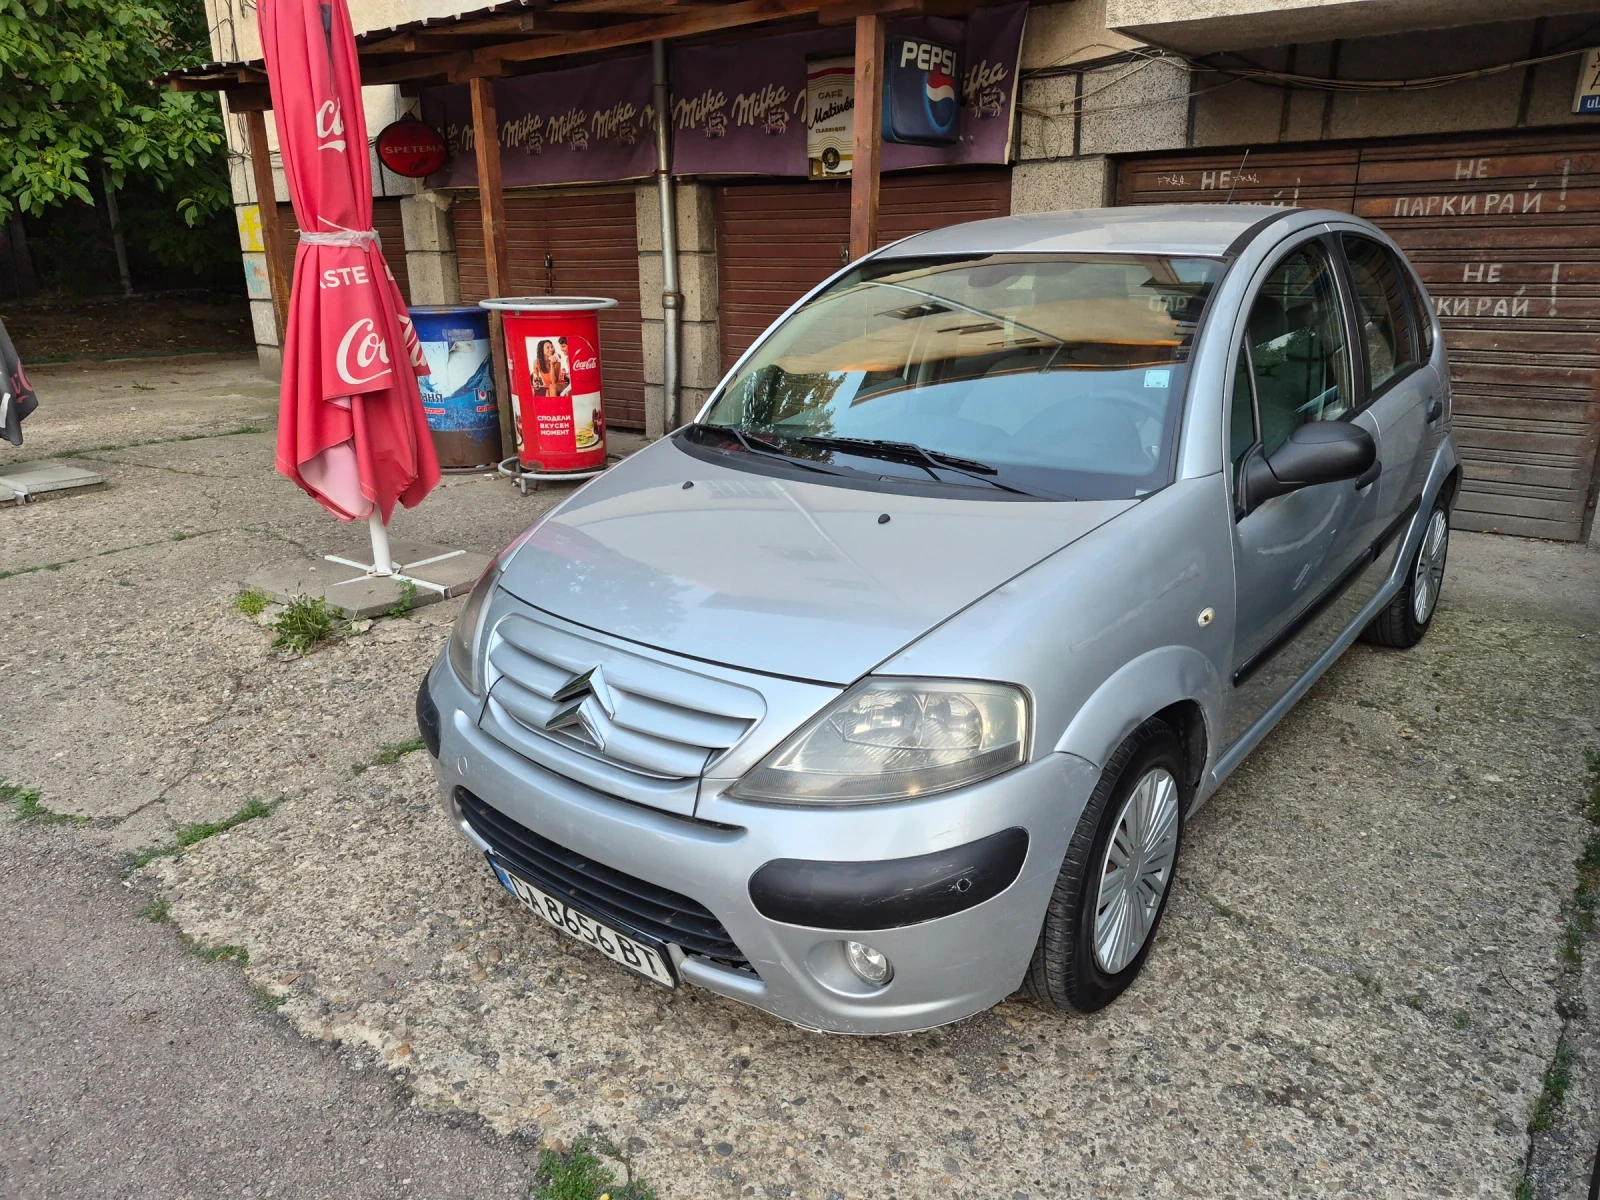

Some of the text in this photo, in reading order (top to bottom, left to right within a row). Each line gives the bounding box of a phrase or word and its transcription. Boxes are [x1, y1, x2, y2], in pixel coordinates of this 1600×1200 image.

[901, 41, 957, 77] PEPSI
[963, 59, 1009, 97] ilka
[672, 88, 729, 131] Milka
[732, 83, 790, 127] Milka
[502, 112, 544, 148] Milka
[546, 106, 588, 145] Milka
[591, 101, 637, 140] Milka
[815, 126, 847, 134] CLASSIQUE
[385, 145, 444, 154] SPETEMA
[1201, 170, 1232, 190] НЕ
[1455, 158, 1491, 181] НЕ
[1462, 263, 1502, 283] НЕ
